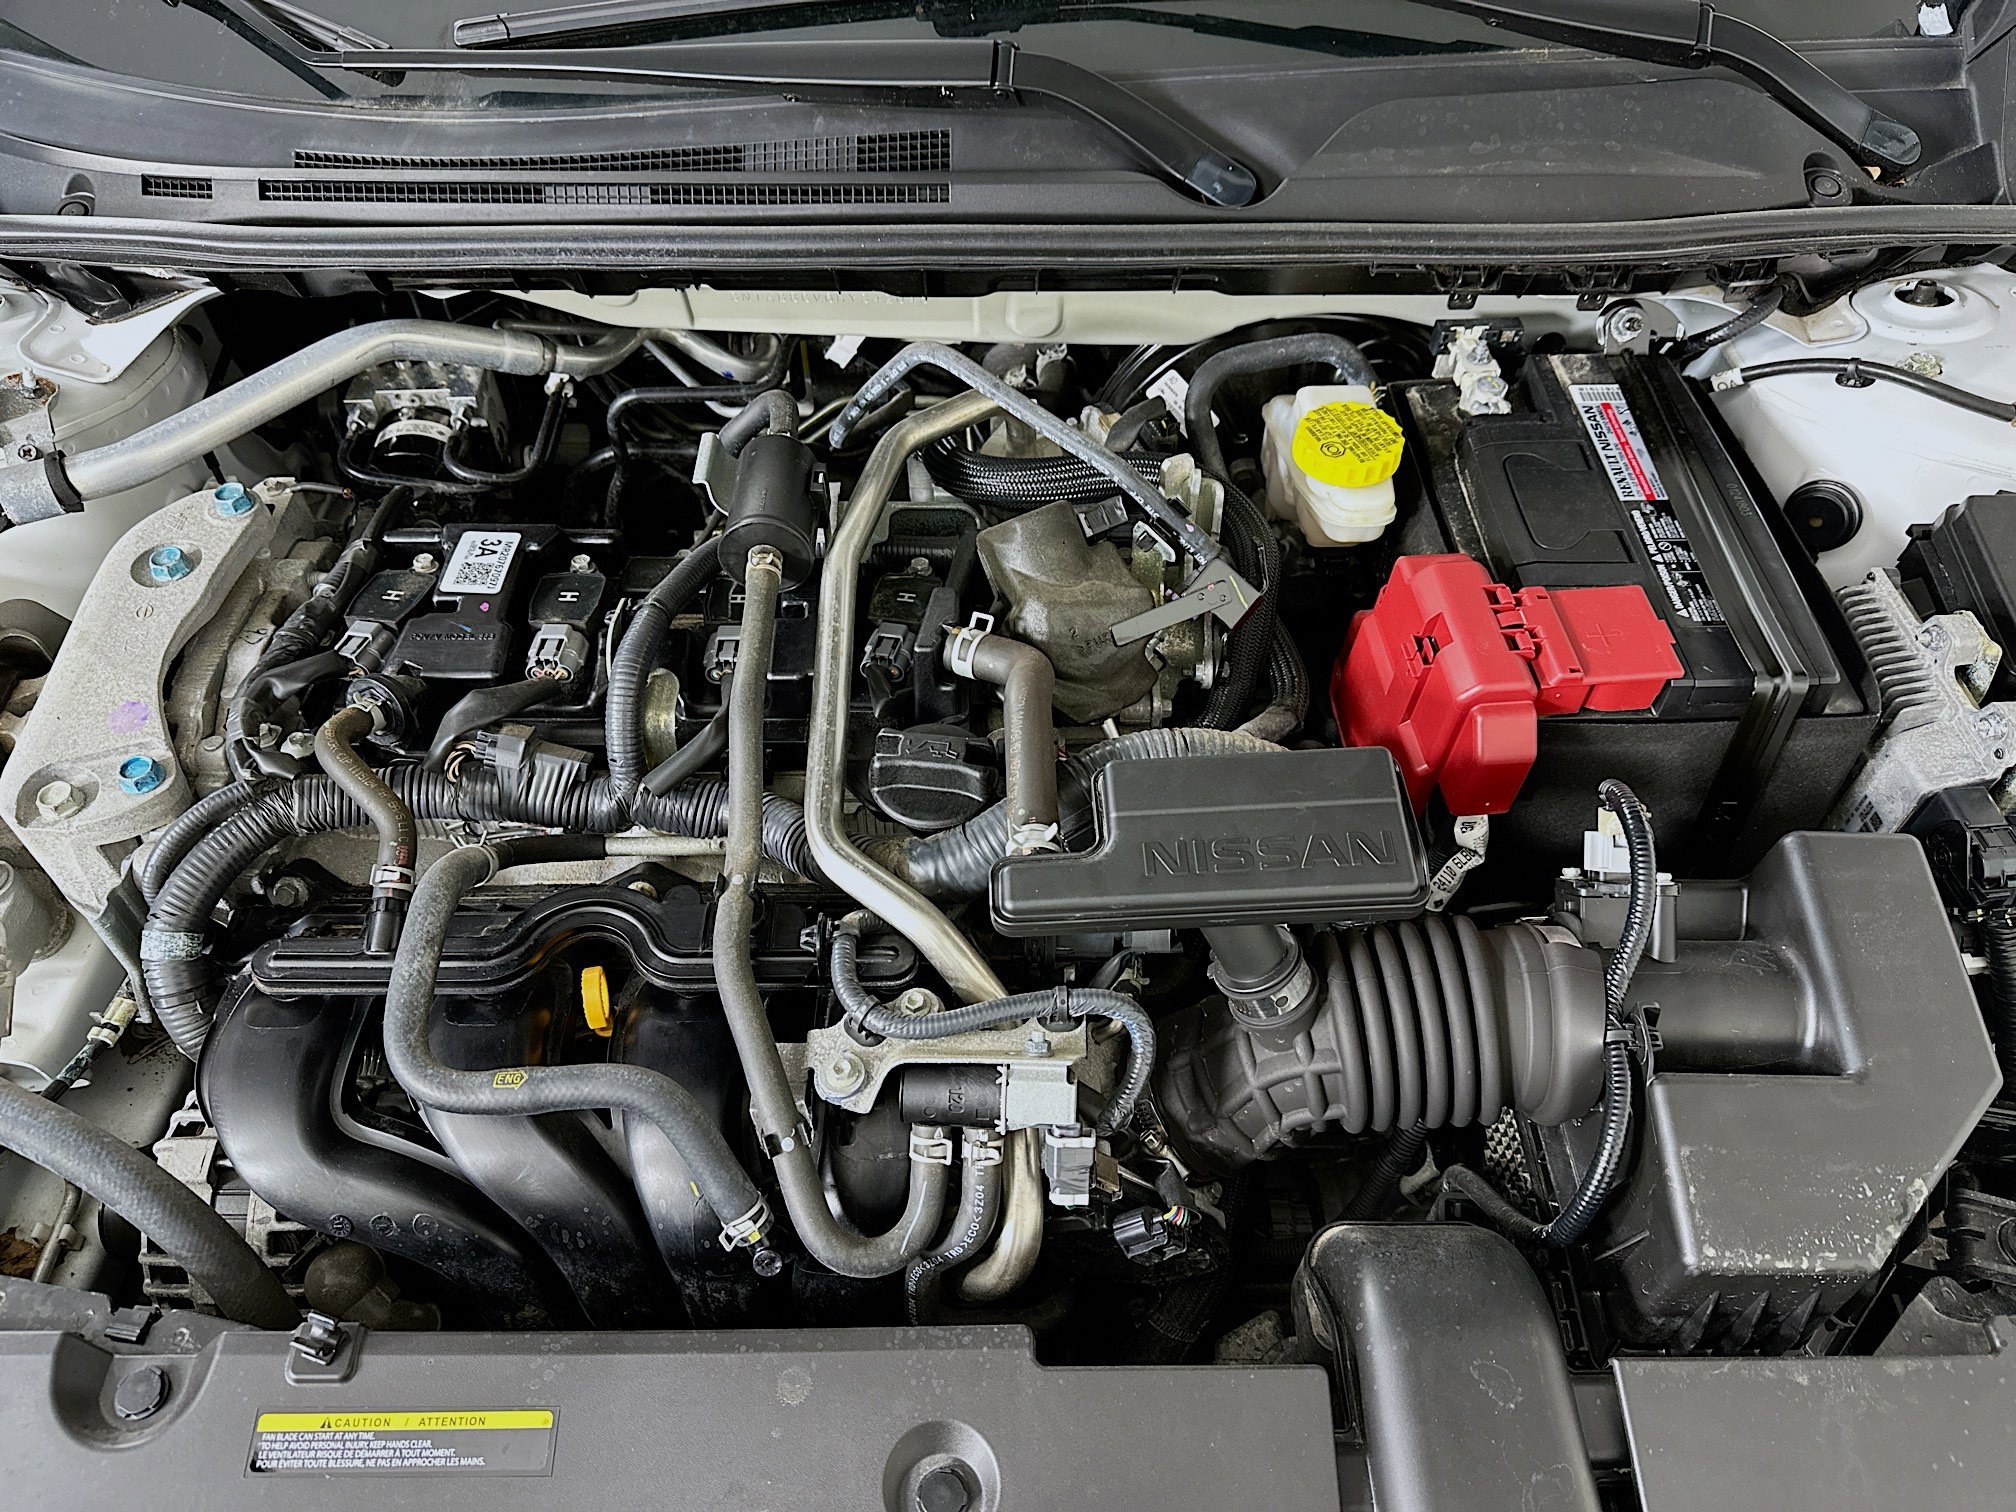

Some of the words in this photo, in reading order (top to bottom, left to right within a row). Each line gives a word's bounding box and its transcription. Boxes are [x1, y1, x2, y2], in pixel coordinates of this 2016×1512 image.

[1582, 405, 1614, 451] NISSAN
[1604, 453, 1635, 498] RENAULT
[474, 538, 503, 558] 3A
[381, 589, 405, 601] H
[558, 591, 580, 602] H
[896, 592, 917, 602] H
[1142, 830, 1398, 877] NISSAN
[497, 1073, 522, 1084] ENG
[334, 1417, 391, 1428] CAUTION
[418, 1416, 486, 1427] ATTENTION
[262, 1432, 275, 1441] FAN
[276, 1432, 298, 1441] BLADE
[298, 1432, 313, 1440] CAN
[314, 1432, 334, 1440] START
[334, 1432, 343, 1440] AT
[262, 1441, 271, 1450] TO
[271, 1441, 289, 1450] HELP
[289, 1441, 310, 1450] AVOID
[311, 1441, 344, 1449] PERSONAL
[369, 1440, 386, 1449] KEEP
[386, 1440, 410, 1448] HANDS
[410, 1440, 432, 1448] CLEAR.
[258, 1450, 268, 1459] LE
[267, 1450, 316, 1459] VENTILATEUR
[316, 1450, 343, 1459] RISQUE
[343, 1450, 354, 1458] DE
[354, 1449, 394, 1458] DÉMARRER
[401, 1449, 421, 1457] TOUT
[421, 1448, 456, 1457] MOMENT.
[256, 1459, 278, 1468] POUR
[304, 1459, 328, 1468] TOUTE
[328, 1459, 365, 1468] BLESSURE,
[365, 1459, 376, 1468] NE
[377, 1458, 391, 1467] PAS
[391, 1458, 402, 1467] EN
[402, 1458, 447, 1467] APPROCHER
[447, 1457, 460, 1466] LES
[460, 1457, 486, 1466] MAINS.
